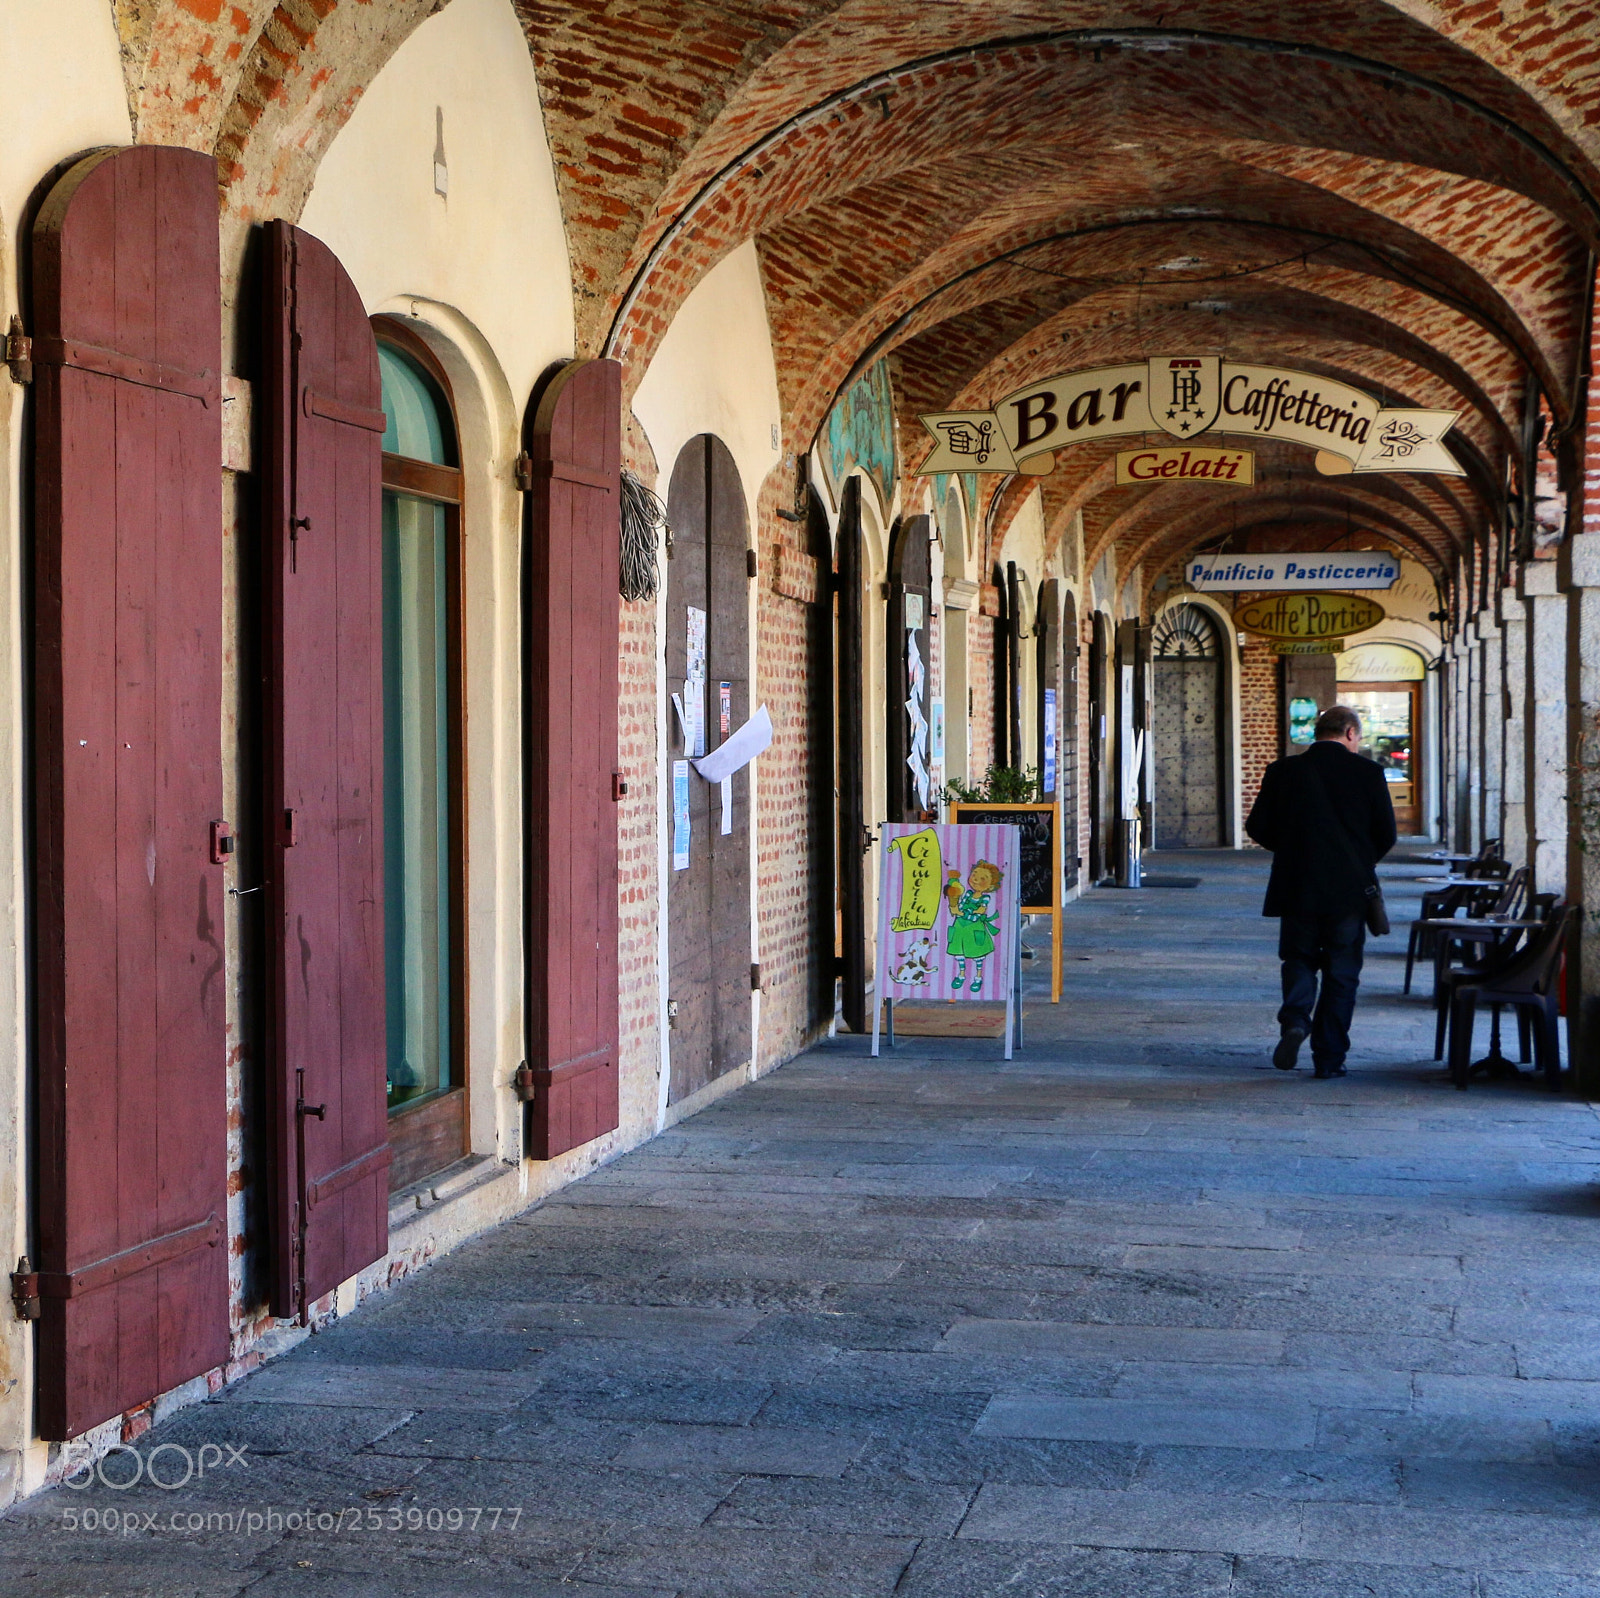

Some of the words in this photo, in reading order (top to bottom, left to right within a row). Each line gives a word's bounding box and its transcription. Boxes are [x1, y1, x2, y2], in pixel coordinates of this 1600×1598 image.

[1010, 381, 1142, 452] Bar
[1223, 374, 1371, 445] Caffetteria
[1128, 451, 1243, 479] Gelati
[1191, 563, 1274, 582] Panificio
[1285, 562, 1395, 579] Pasticceria
[1271, 642, 1341, 654] Gelateria
[1341, 654, 1416, 679] Gelateria
[907, 837, 930, 914] Cremeria
